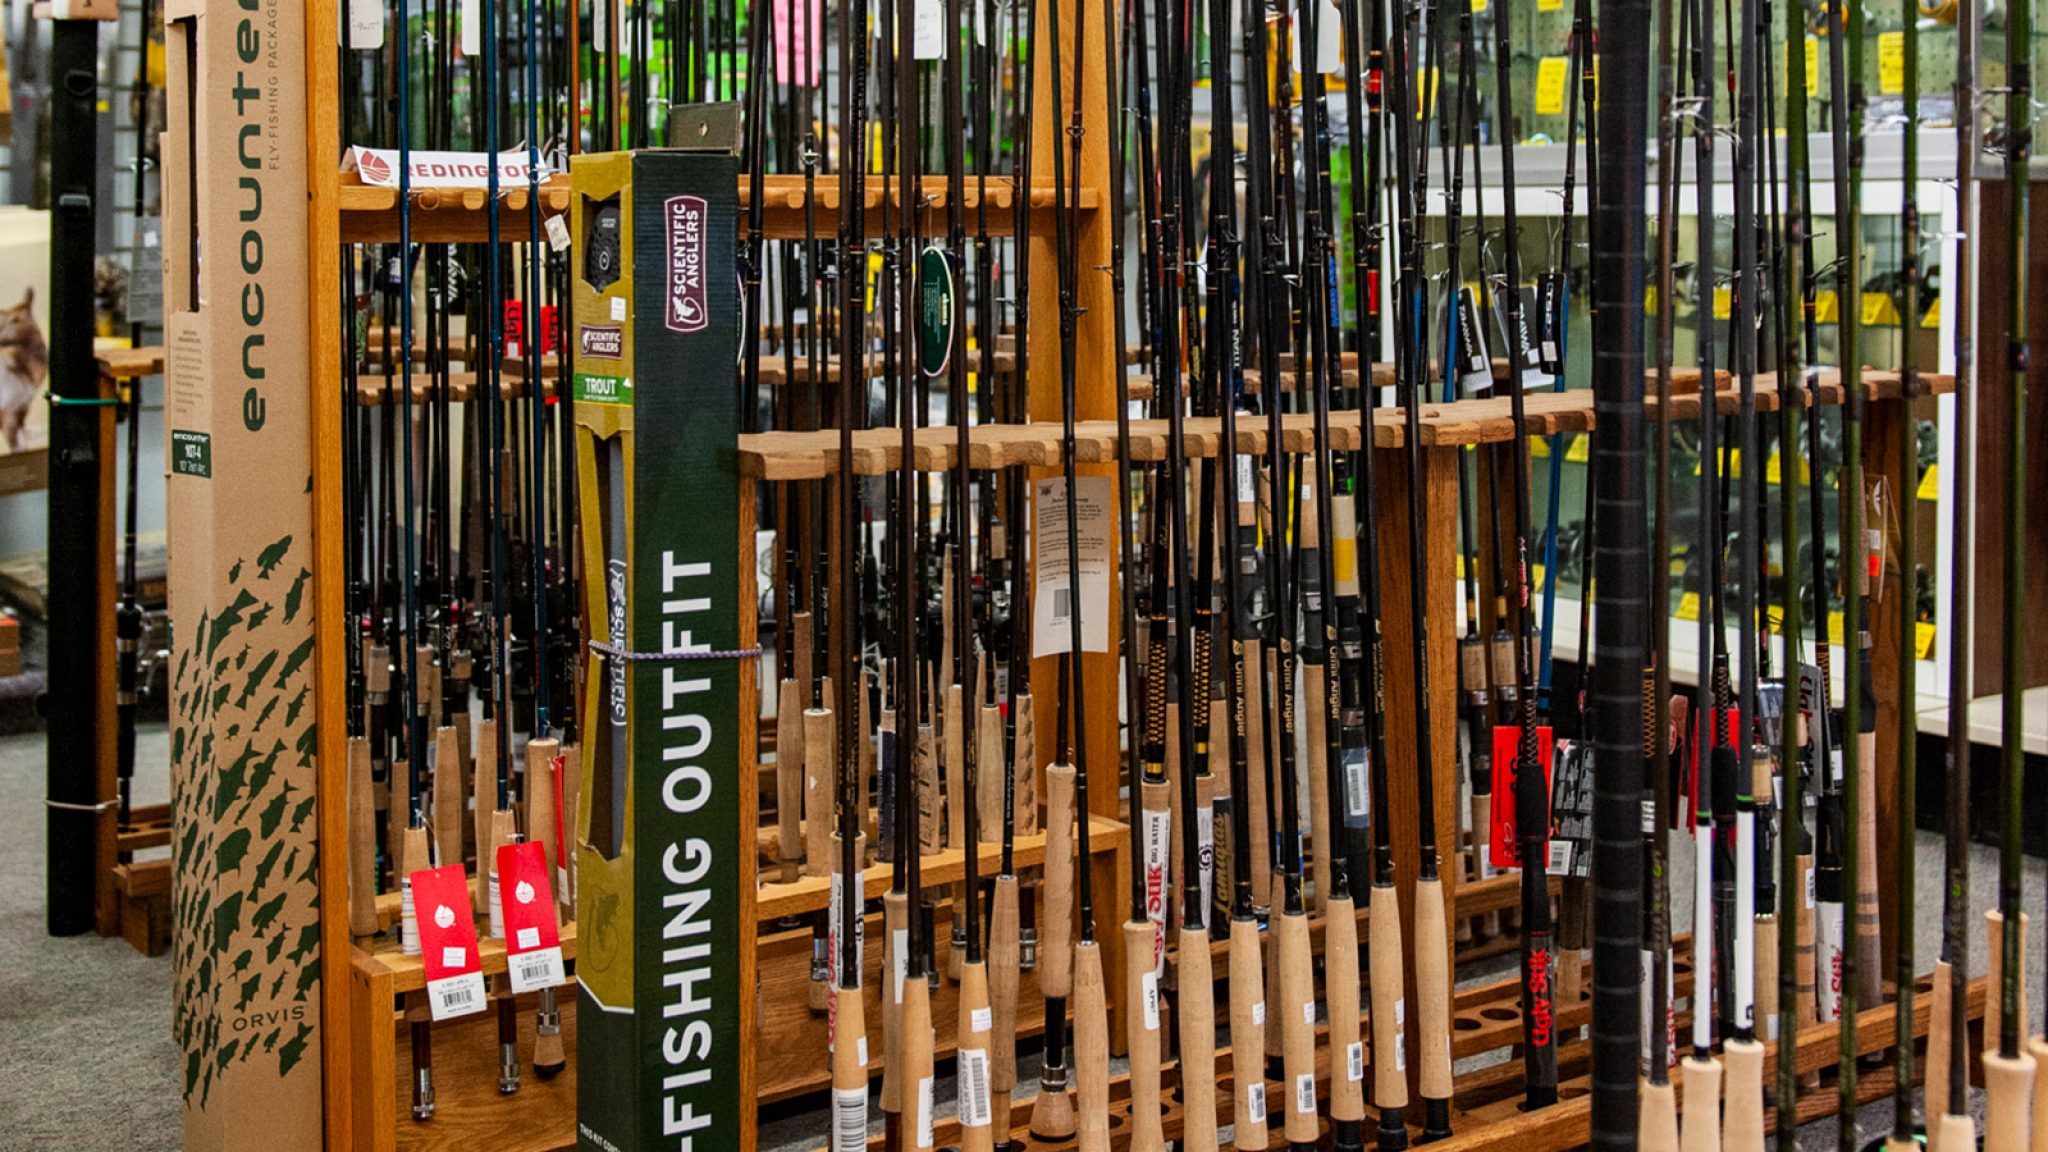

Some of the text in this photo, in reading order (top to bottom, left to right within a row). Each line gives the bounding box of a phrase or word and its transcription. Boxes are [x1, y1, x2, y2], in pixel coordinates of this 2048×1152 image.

[266, 0, 280, 171] FLY-FISHING PACKAGE
[672, 203, 687, 295] SCIENTIFIC
[685, 209, 699, 289] ANGLERS
[589, 331, 621, 343] SCIENTIFIC
[592, 342, 619, 353] ANGLERS
[585, 377, 617, 395] TROUT
[662, 551, 712, 814] OUTFIT
[1283, 658, 1294, 734] Omni Angler
[1329, 645, 1339, 720] Omni Angler
[232, 1005, 305, 1032] ORVIS
[1528, 948, 1553, 1047] Ugly Stik
